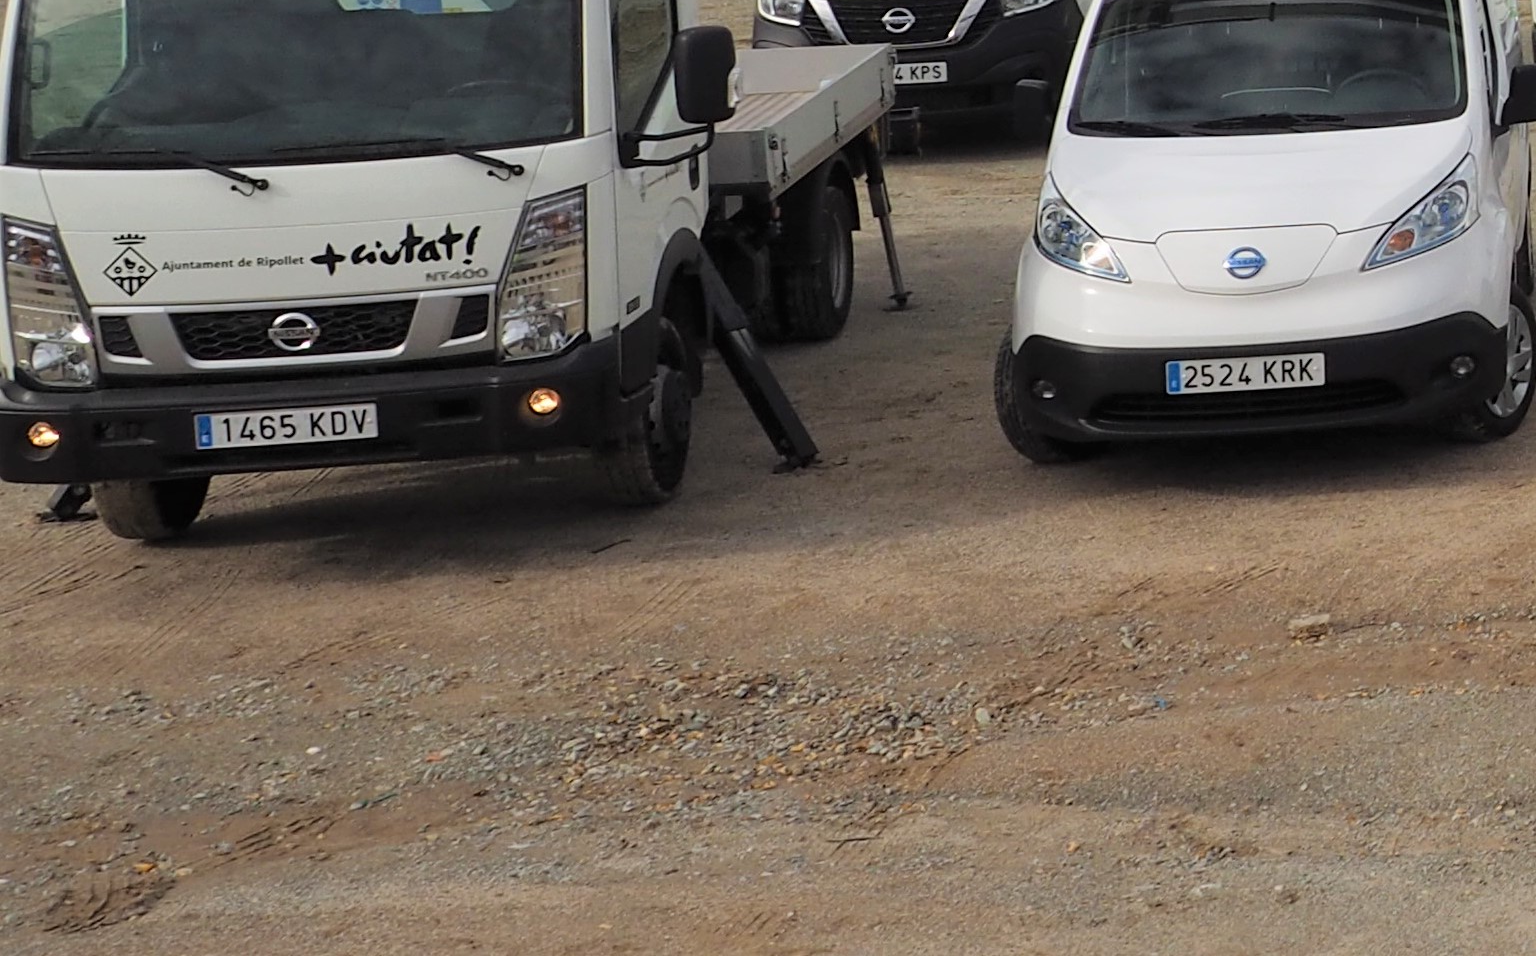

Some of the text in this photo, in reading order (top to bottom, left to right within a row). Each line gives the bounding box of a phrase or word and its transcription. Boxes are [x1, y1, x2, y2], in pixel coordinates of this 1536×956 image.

[910, 65, 942, 80] KPS
[162, 259, 233, 271] Ajuntament
[238, 257, 252, 267] de
[257, 255, 304, 268] Ripollet
[425, 267, 488, 283] NT400
[1184, 358, 1314, 389] 2524 KRK
[222, 409, 367, 442] 1465 KDV
